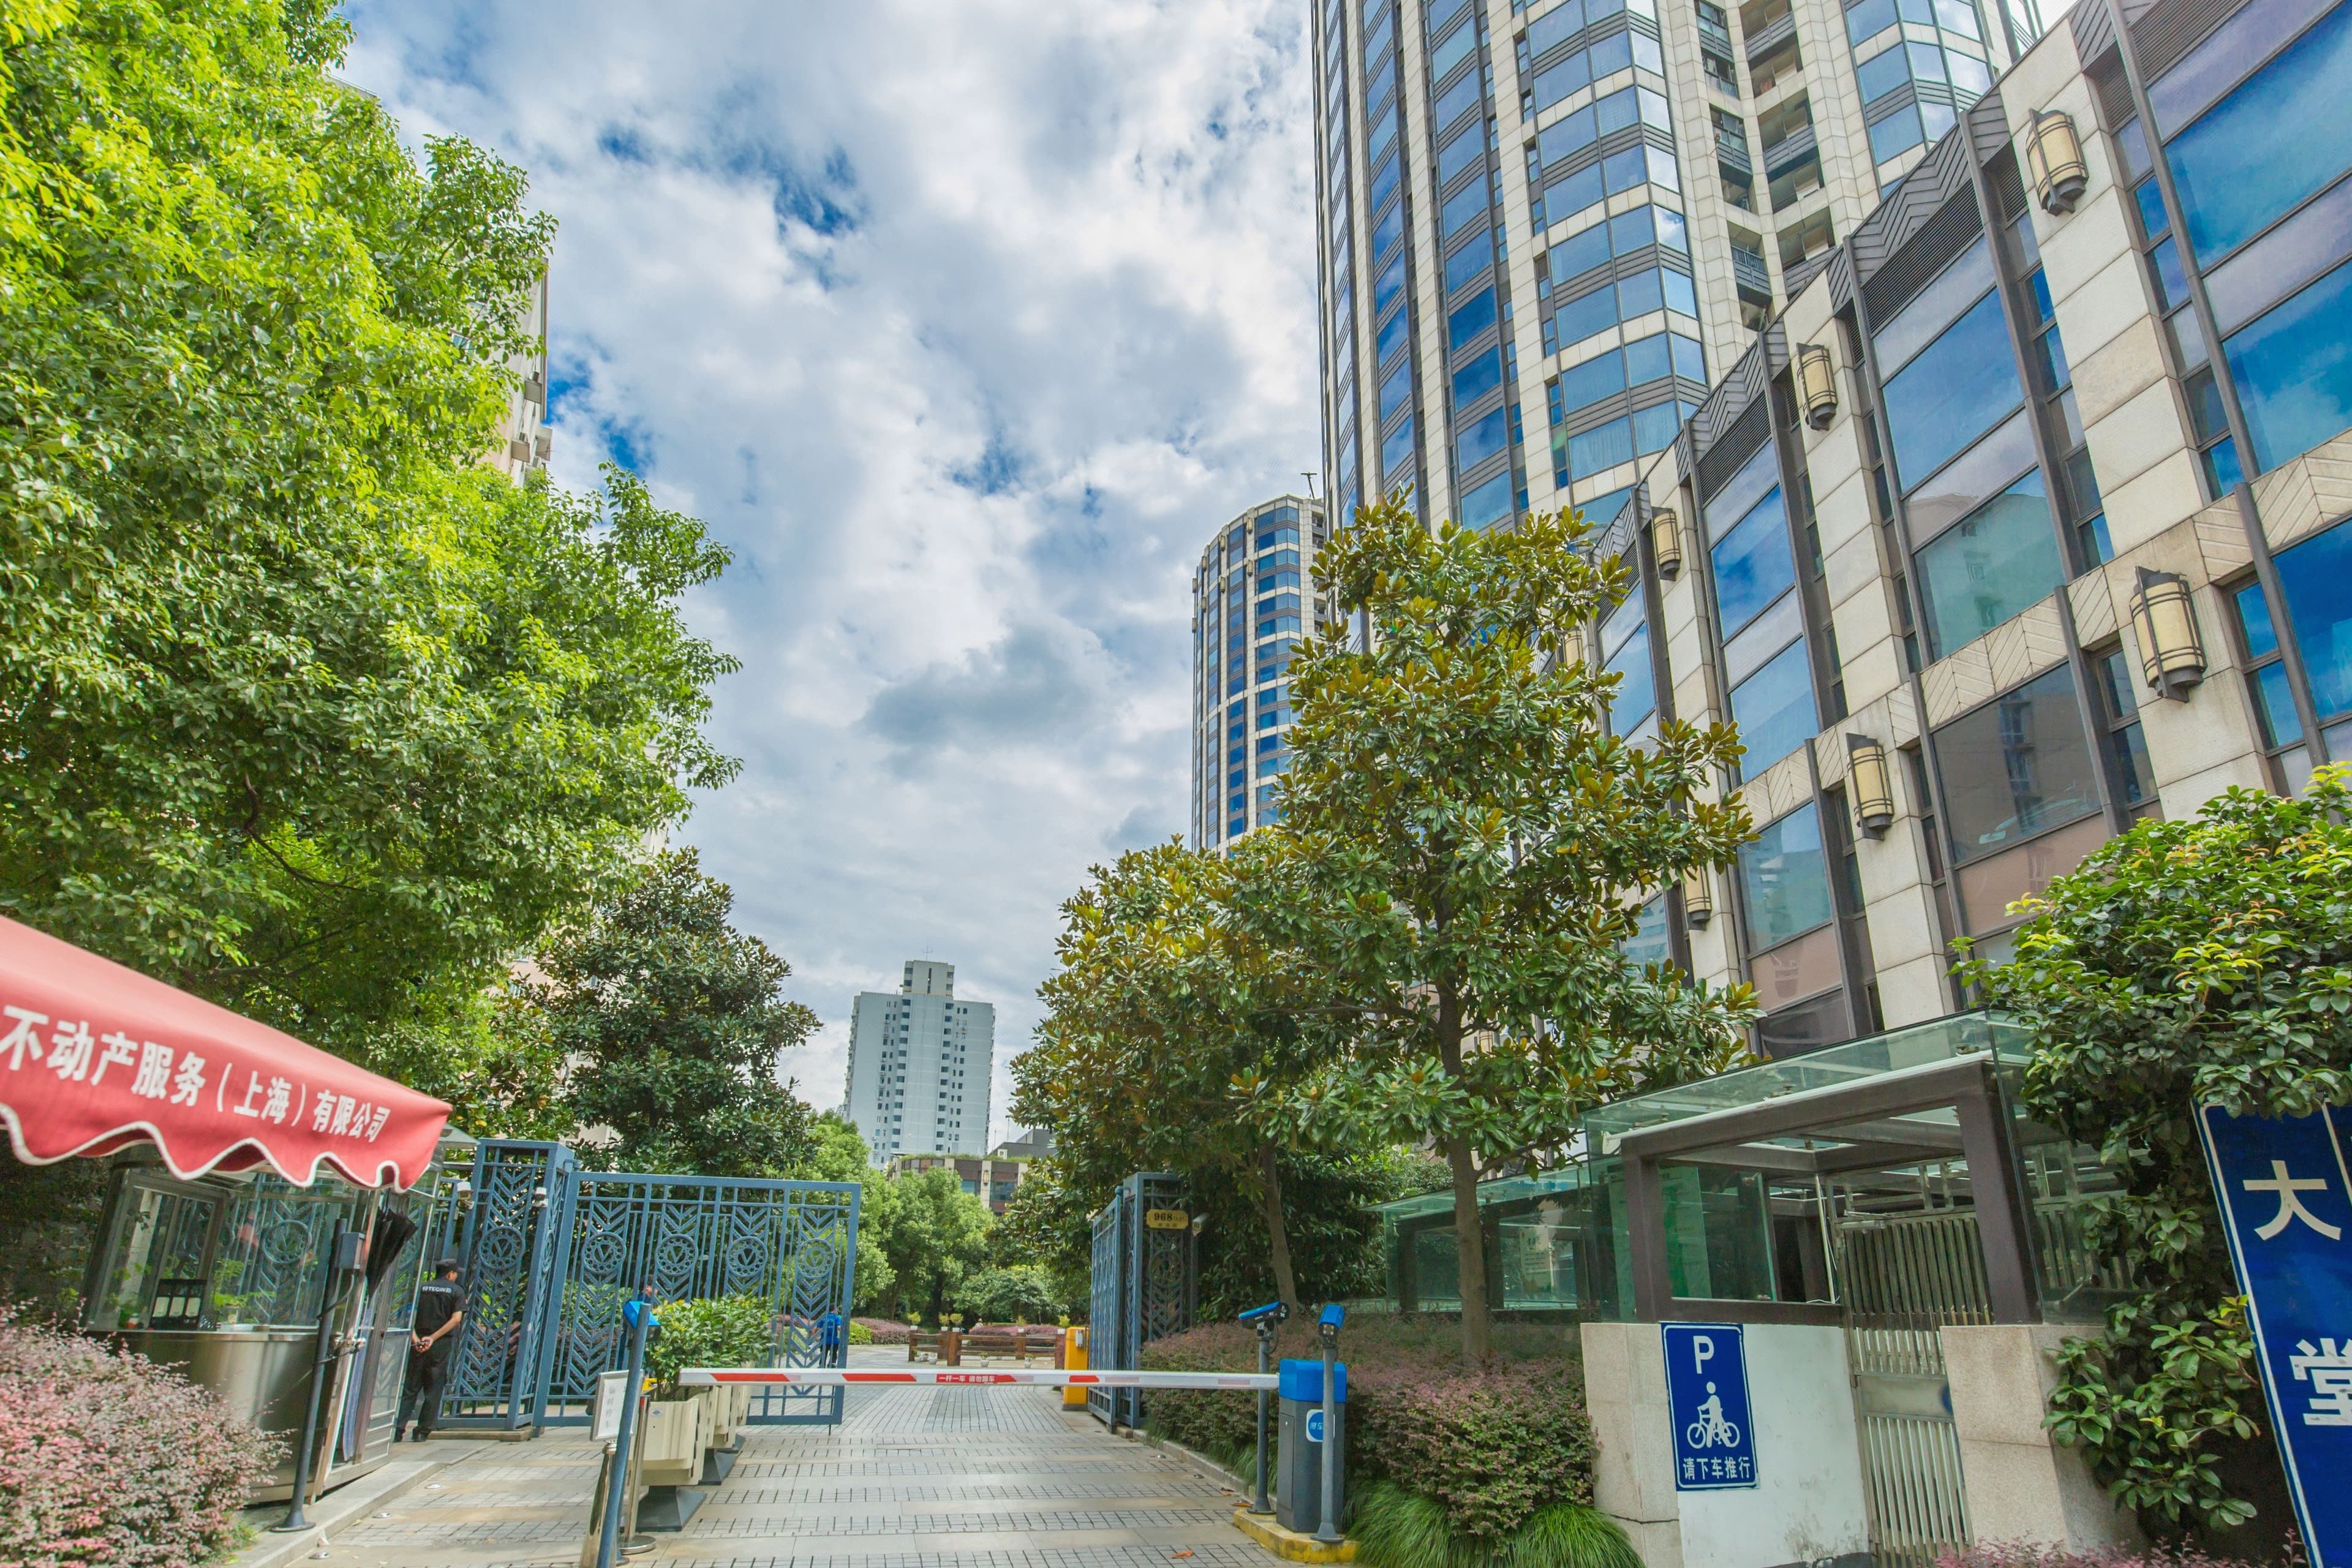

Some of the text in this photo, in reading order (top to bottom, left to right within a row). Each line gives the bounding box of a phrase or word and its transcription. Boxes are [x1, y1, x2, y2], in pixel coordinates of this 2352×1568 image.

[1693, 1335, 1714, 1374] P
[1683, 1456, 1751, 1480] 请下车推行
